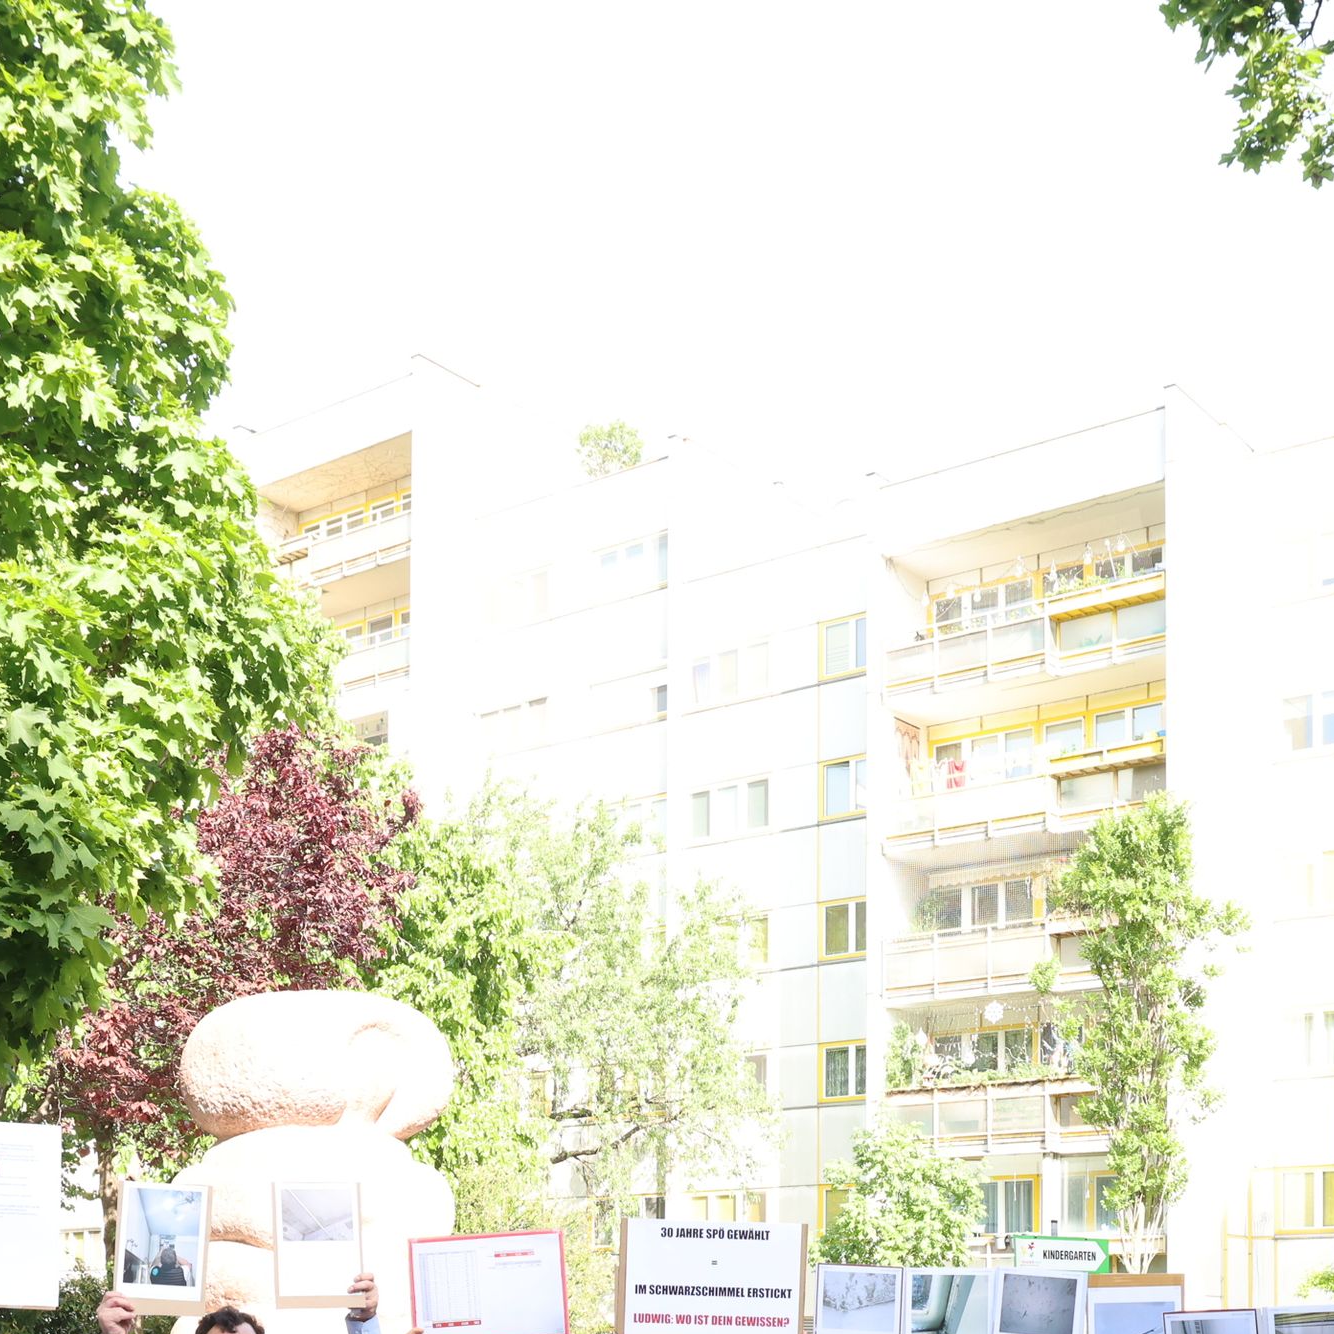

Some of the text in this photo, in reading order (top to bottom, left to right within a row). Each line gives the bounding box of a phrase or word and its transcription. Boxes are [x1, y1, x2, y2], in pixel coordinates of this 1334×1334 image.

[661, 1226, 771, 1240] 30 JAHRE SPÖ GEWÄHLT
[1043, 1250, 1097, 1261] KINDERGARTEN
[635, 1284, 793, 1299] IM SCHWARZSCHIMMEL ERSTICKT
[633, 1312, 790, 1328] LUDWIG: WO IST DEIN GEWISSEN?
